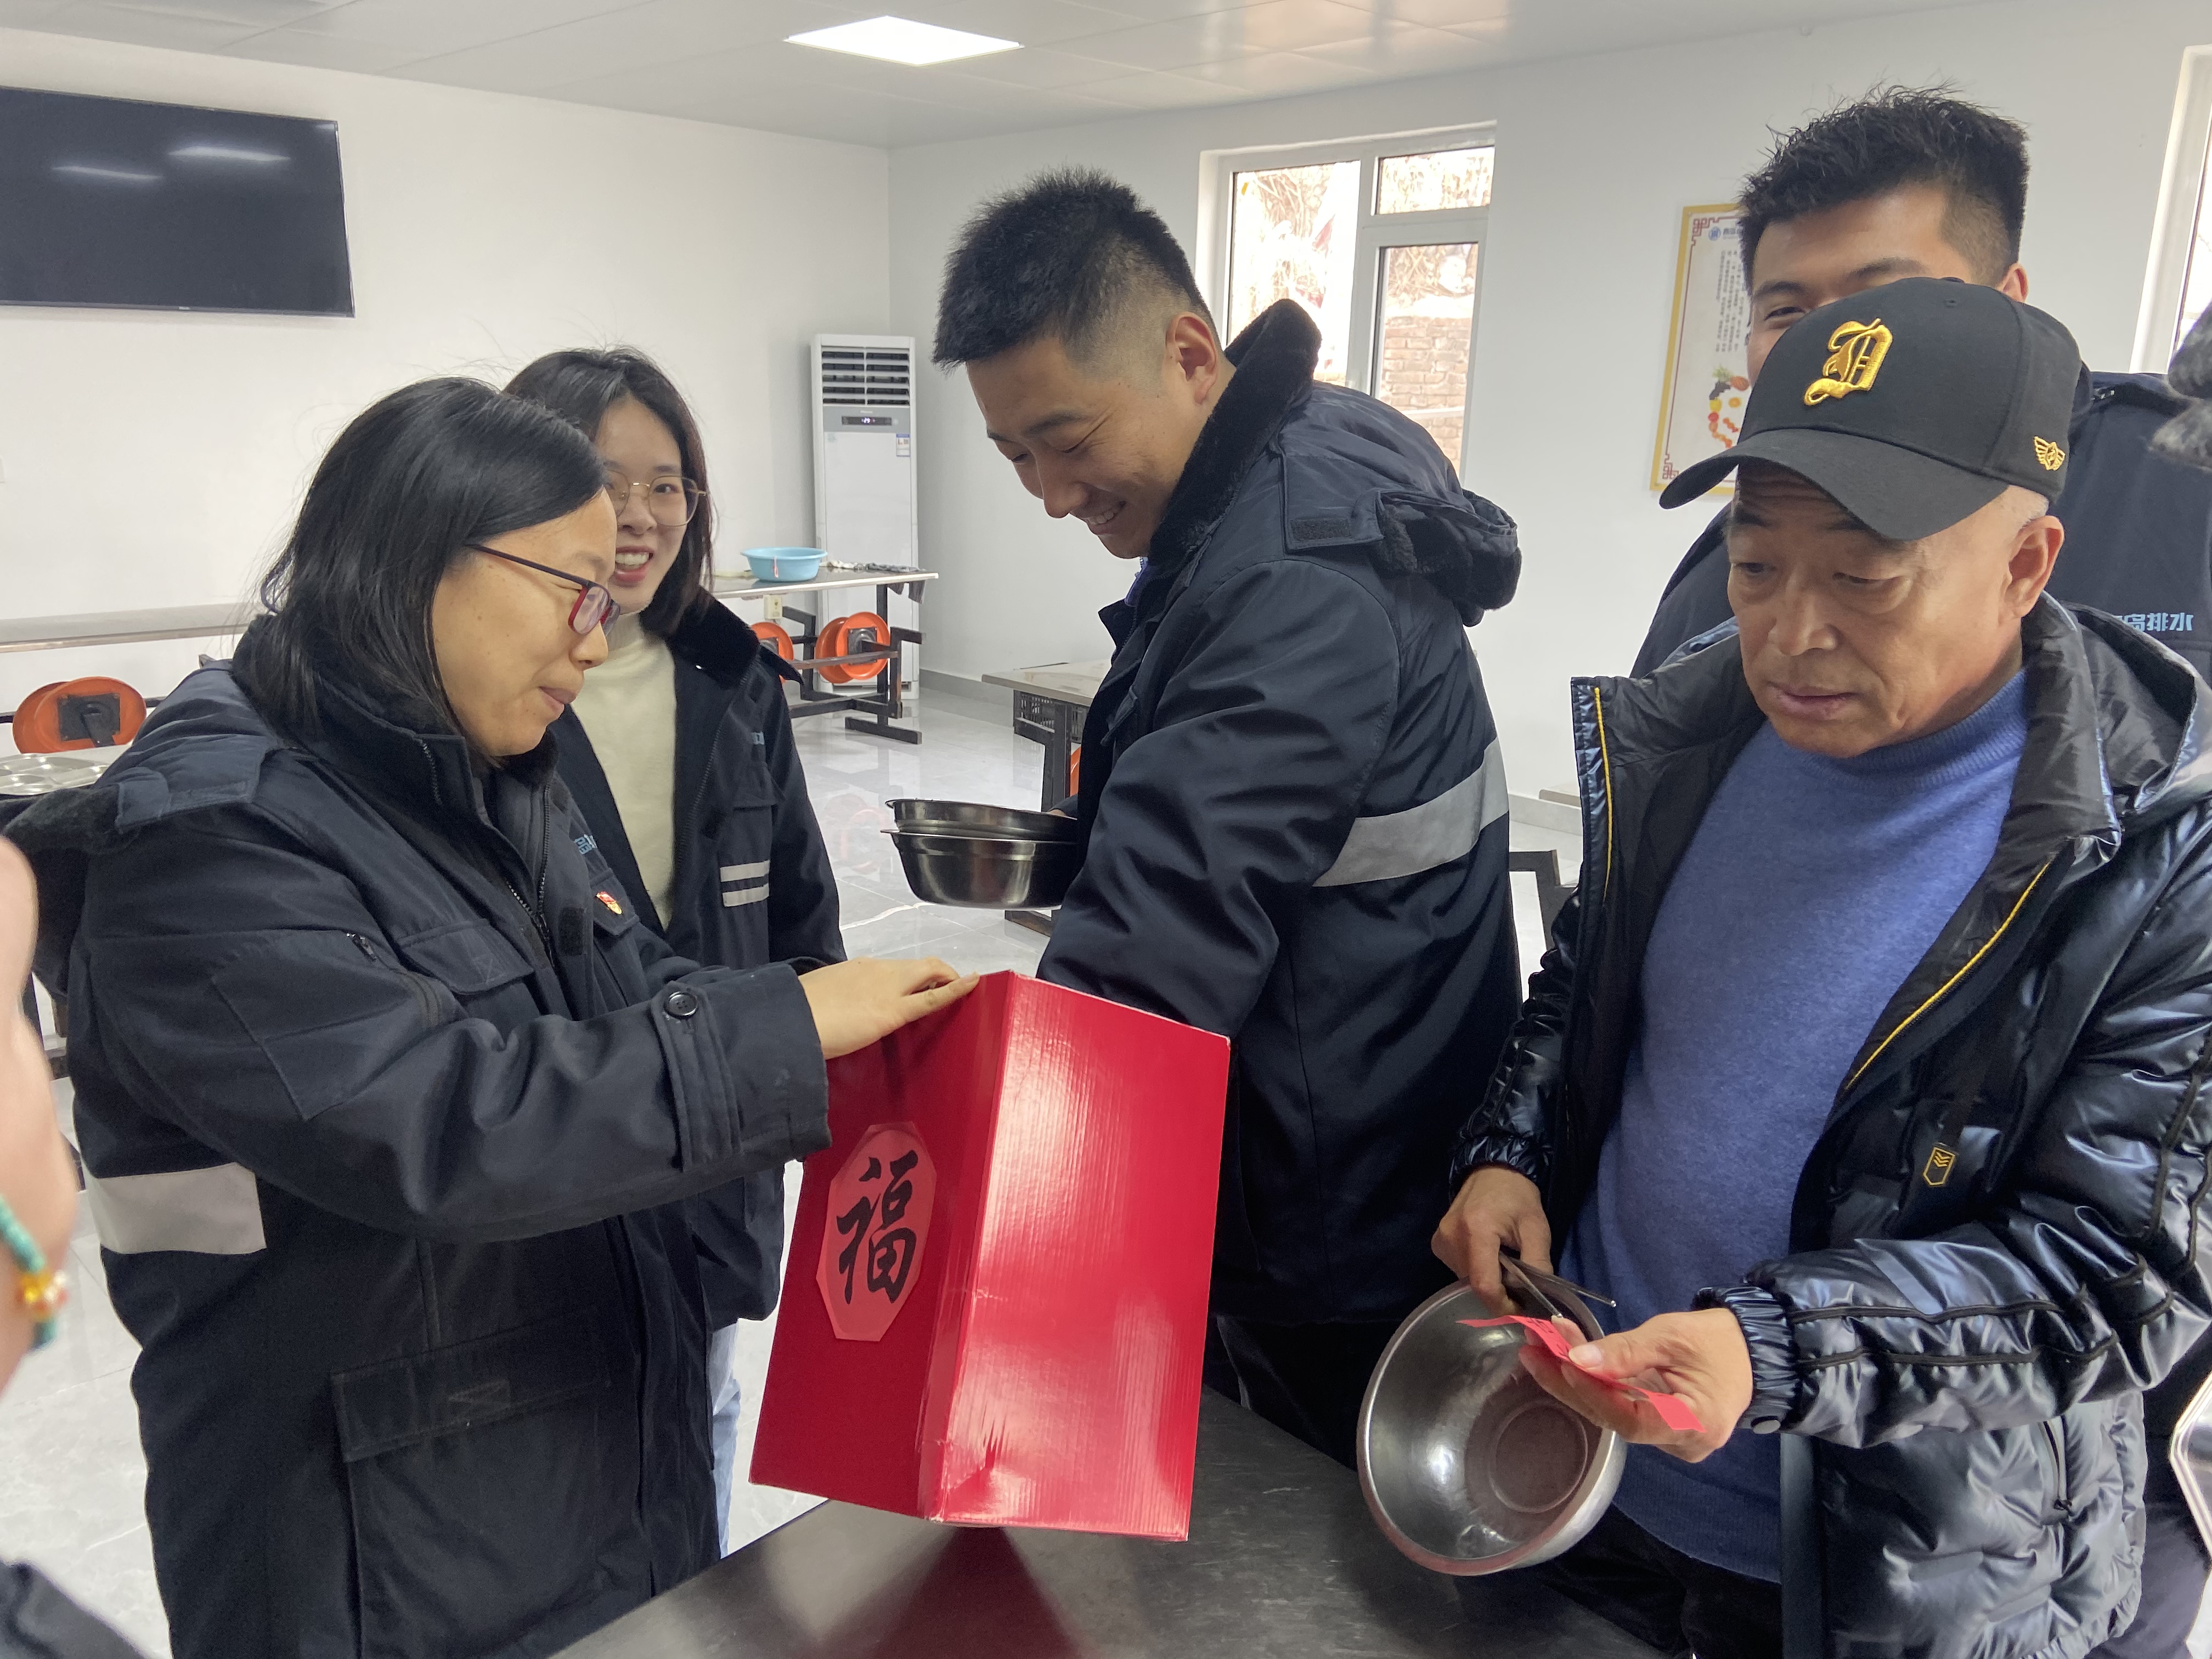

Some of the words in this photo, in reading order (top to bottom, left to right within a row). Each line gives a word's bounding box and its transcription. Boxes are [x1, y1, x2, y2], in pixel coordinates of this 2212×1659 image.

[2114, 612, 2194, 631] 岛排水
[836, 1150, 918, 1305] 福
